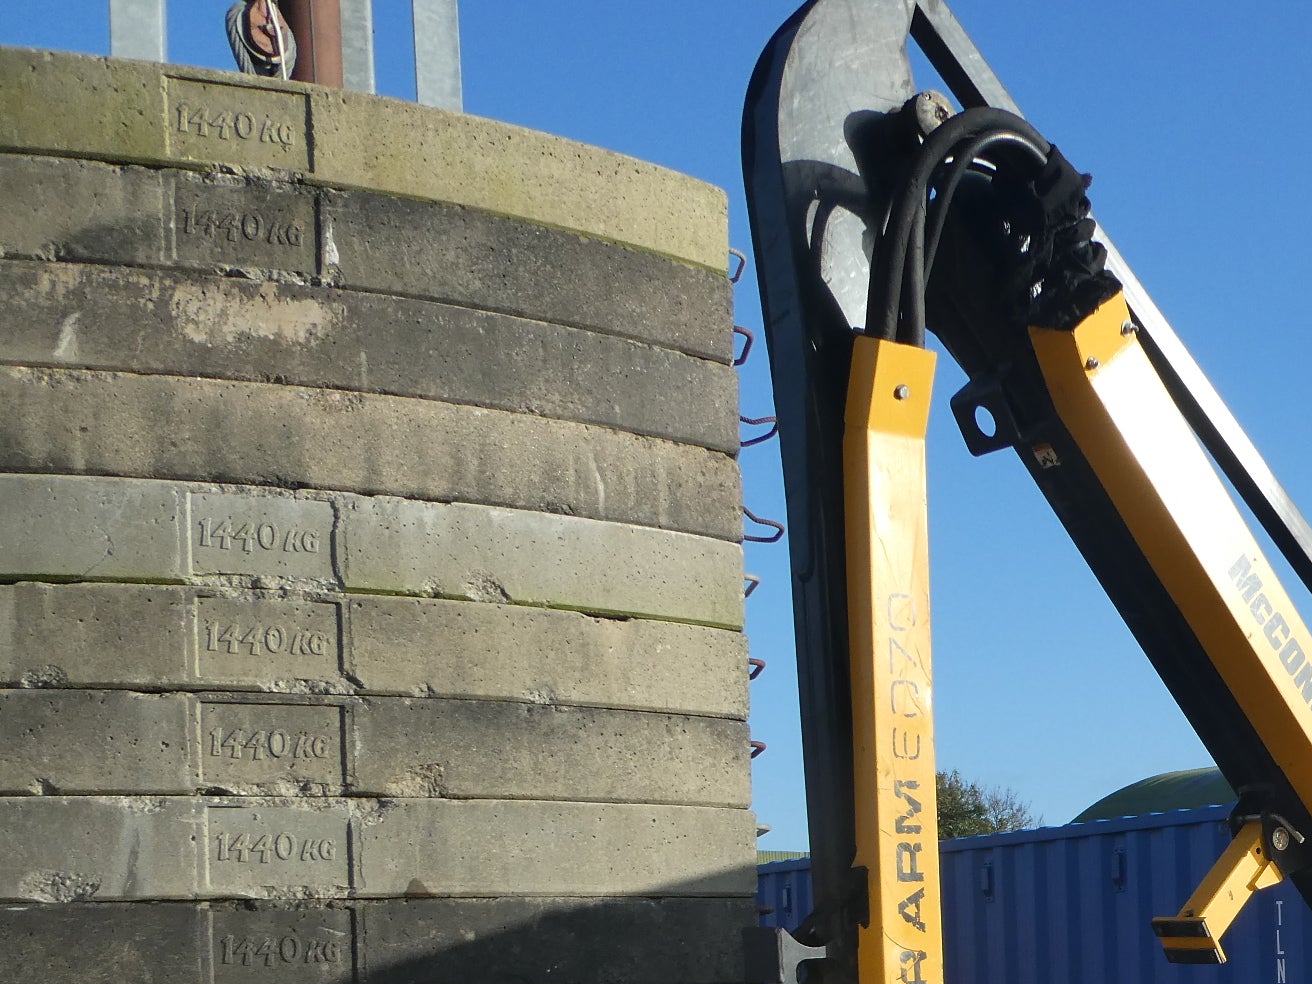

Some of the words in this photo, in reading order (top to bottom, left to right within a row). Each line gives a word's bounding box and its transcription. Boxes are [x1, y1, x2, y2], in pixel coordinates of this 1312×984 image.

[176, 103, 256, 140] 1440
[183, 204, 264, 242] 1440
[198, 518, 279, 552] 1440
[206, 621, 287, 655] 1440
[209, 727, 290, 761] 1440
[216, 832, 297, 864] 1440
[894, 779, 926, 933] ARM
[221, 935, 301, 967] 1440
